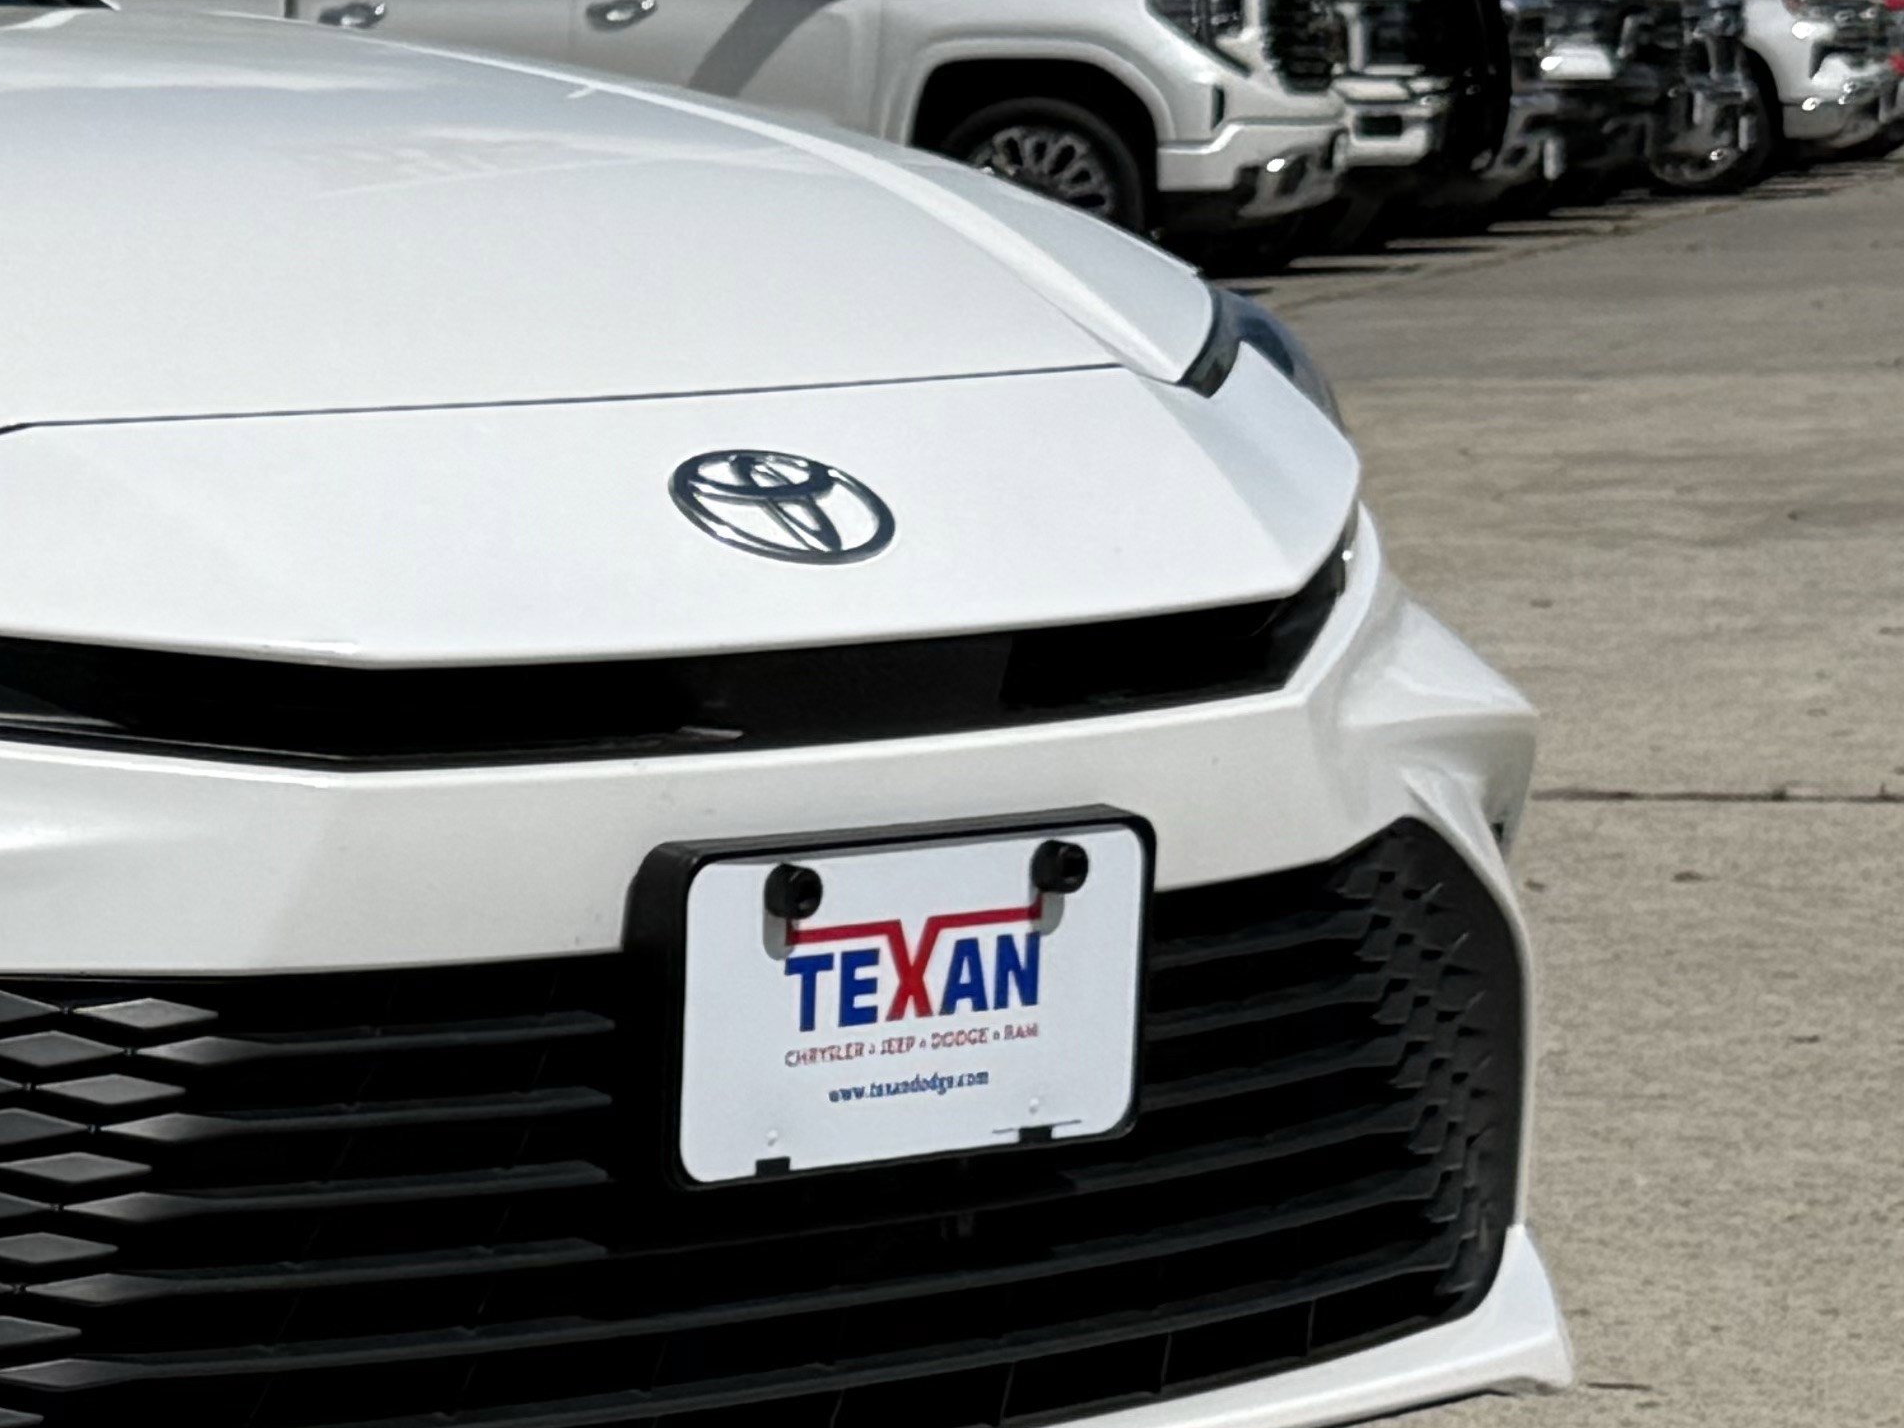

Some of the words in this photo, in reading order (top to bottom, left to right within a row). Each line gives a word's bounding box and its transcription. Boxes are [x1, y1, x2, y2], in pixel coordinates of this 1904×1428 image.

[785, 905, 1041, 1032] TEXAN
[785, 1042, 864, 1067] CHRYSLER
[880, 1035, 916, 1056] JEEP
[930, 1027, 990, 1050] DODGE
[1003, 1023, 1039, 1040] RAM
[829, 1071, 989, 1102] www.texandodge.com
